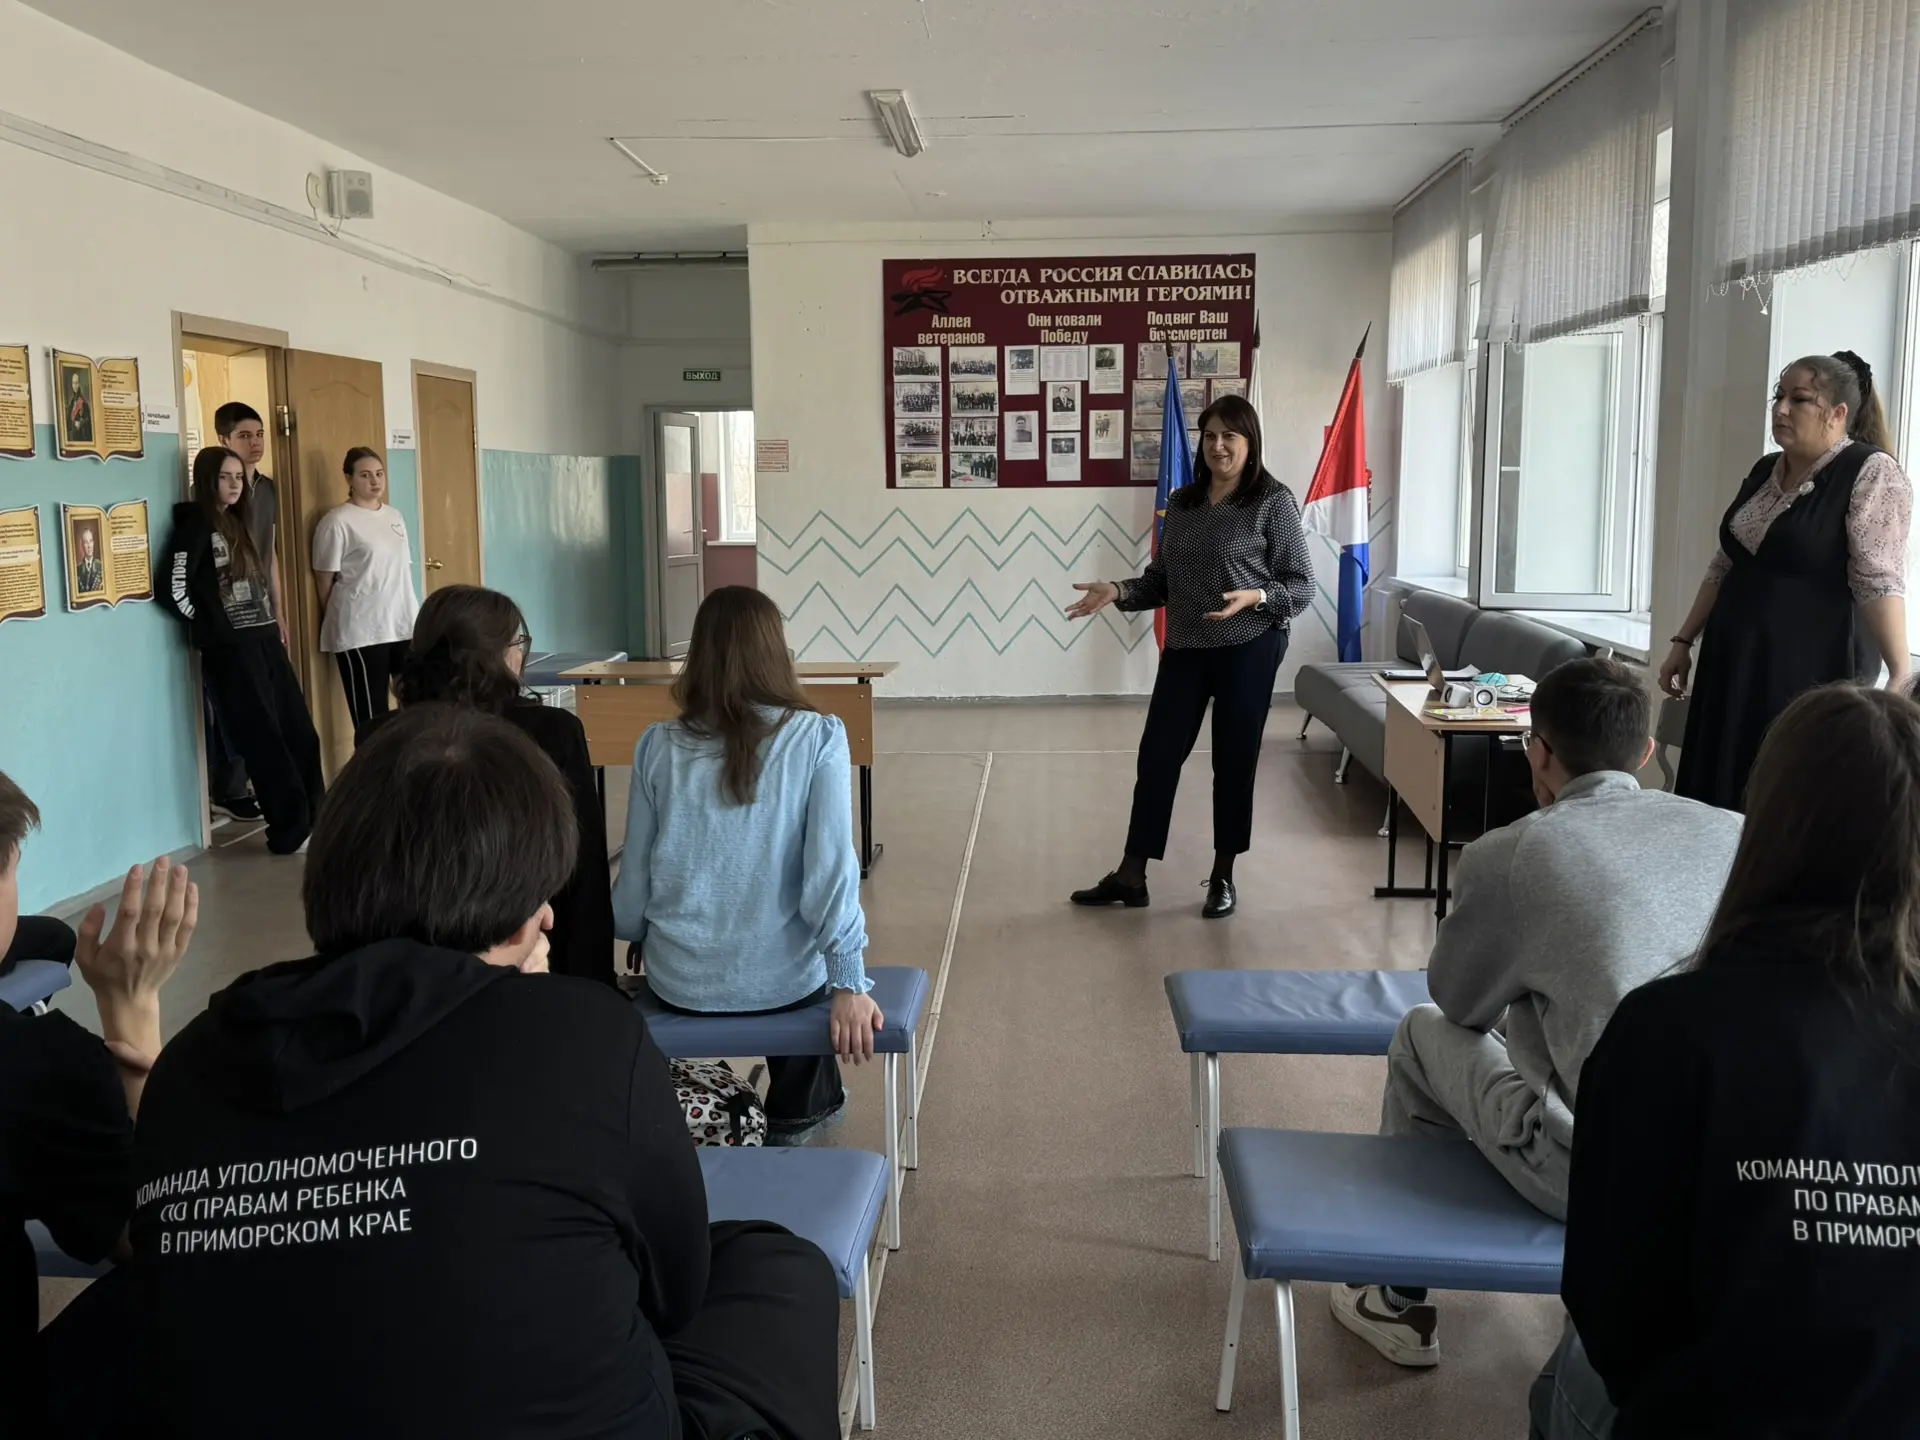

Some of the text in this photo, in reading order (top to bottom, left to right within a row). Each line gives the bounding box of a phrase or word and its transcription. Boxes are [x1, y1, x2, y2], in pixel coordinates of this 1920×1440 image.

[953, 263, 1254, 287] ВСЕГДА РОССИЯ СЛАВИЛАСЬ
[1000, 285, 1252, 304] ОТВАЖНЫМИ ГЕРОЯМИ!
[931, 314, 971, 328] Аллея
[1027, 312, 1102, 327] Они ковали
[1147, 310, 1229, 326] Подвиг Ваш
[917, 332, 986, 346] ветеранов
[1040, 328, 1089, 344] Победу
[685, 371, 719, 381] ВЫХОД
[136, 1138, 478, 1209] КОМАНДА УПОЛНОМОЧЕННОГО
[1736, 1158, 1920, 1187] КОМАНДА УПОЛ
[193, 1190, 288, 1220] ПРАВАМ
[296, 1176, 407, 1211] РЕБЕНКА
[1794, 1188, 1828, 1212] ПО
[160, 1208, 412, 1254] В ПРИМОРСКОМ КРАЕ
[1792, 1219, 1920, 1249] В ПРИМОР
